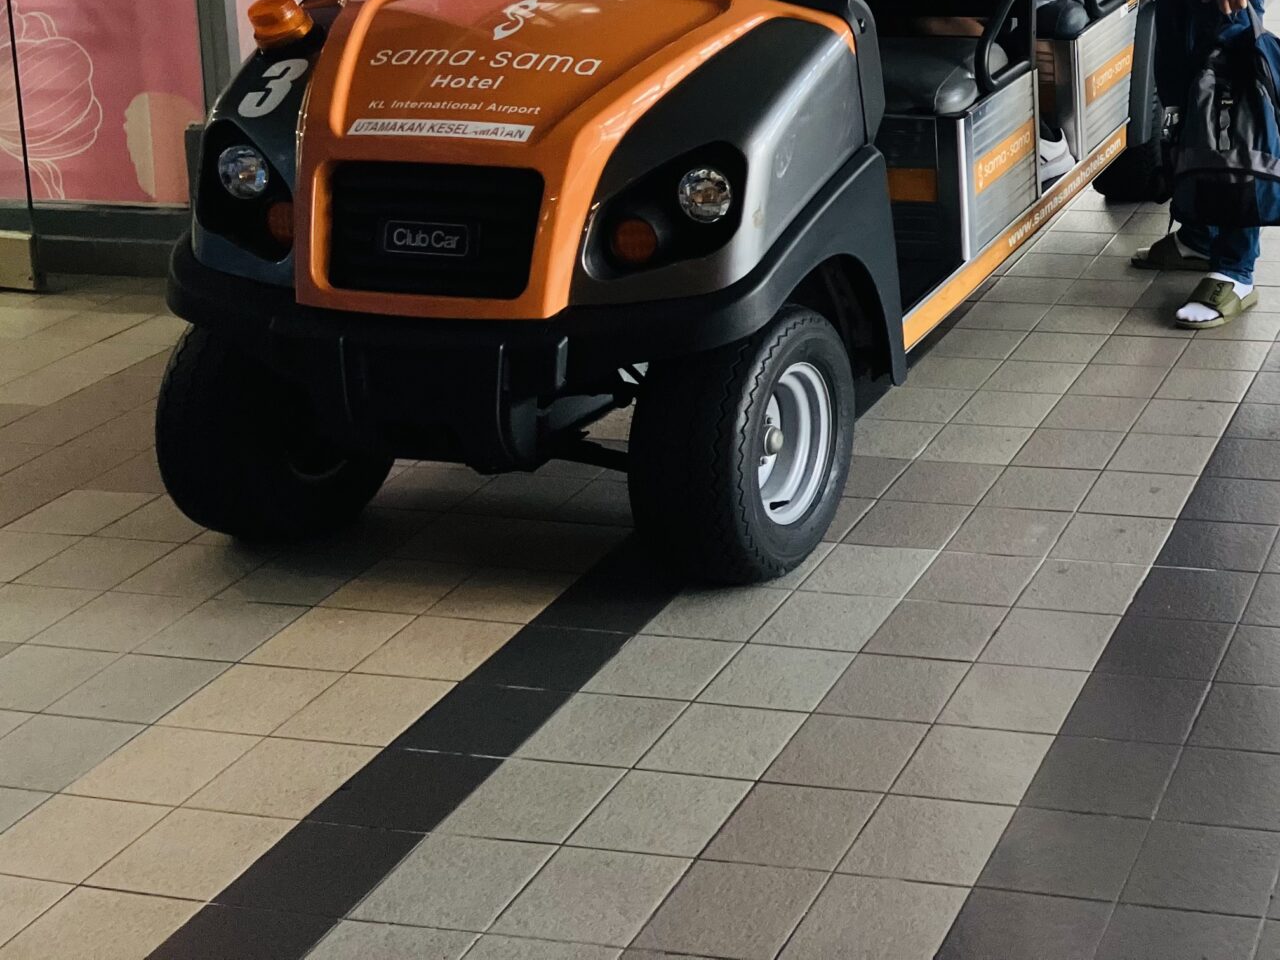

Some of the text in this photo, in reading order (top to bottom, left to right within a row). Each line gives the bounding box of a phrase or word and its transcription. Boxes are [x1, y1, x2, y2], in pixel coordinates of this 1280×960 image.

[237, 58, 309, 118] 3
[430, 74, 505, 90] Hotel
[368, 100, 541, 115] KL International Airport
[353, 121, 427, 134] UTAMAKAN
[1008, 137, 1122, 248] www.samasamahotels.com
[393, 228, 460, 249] Club Car
